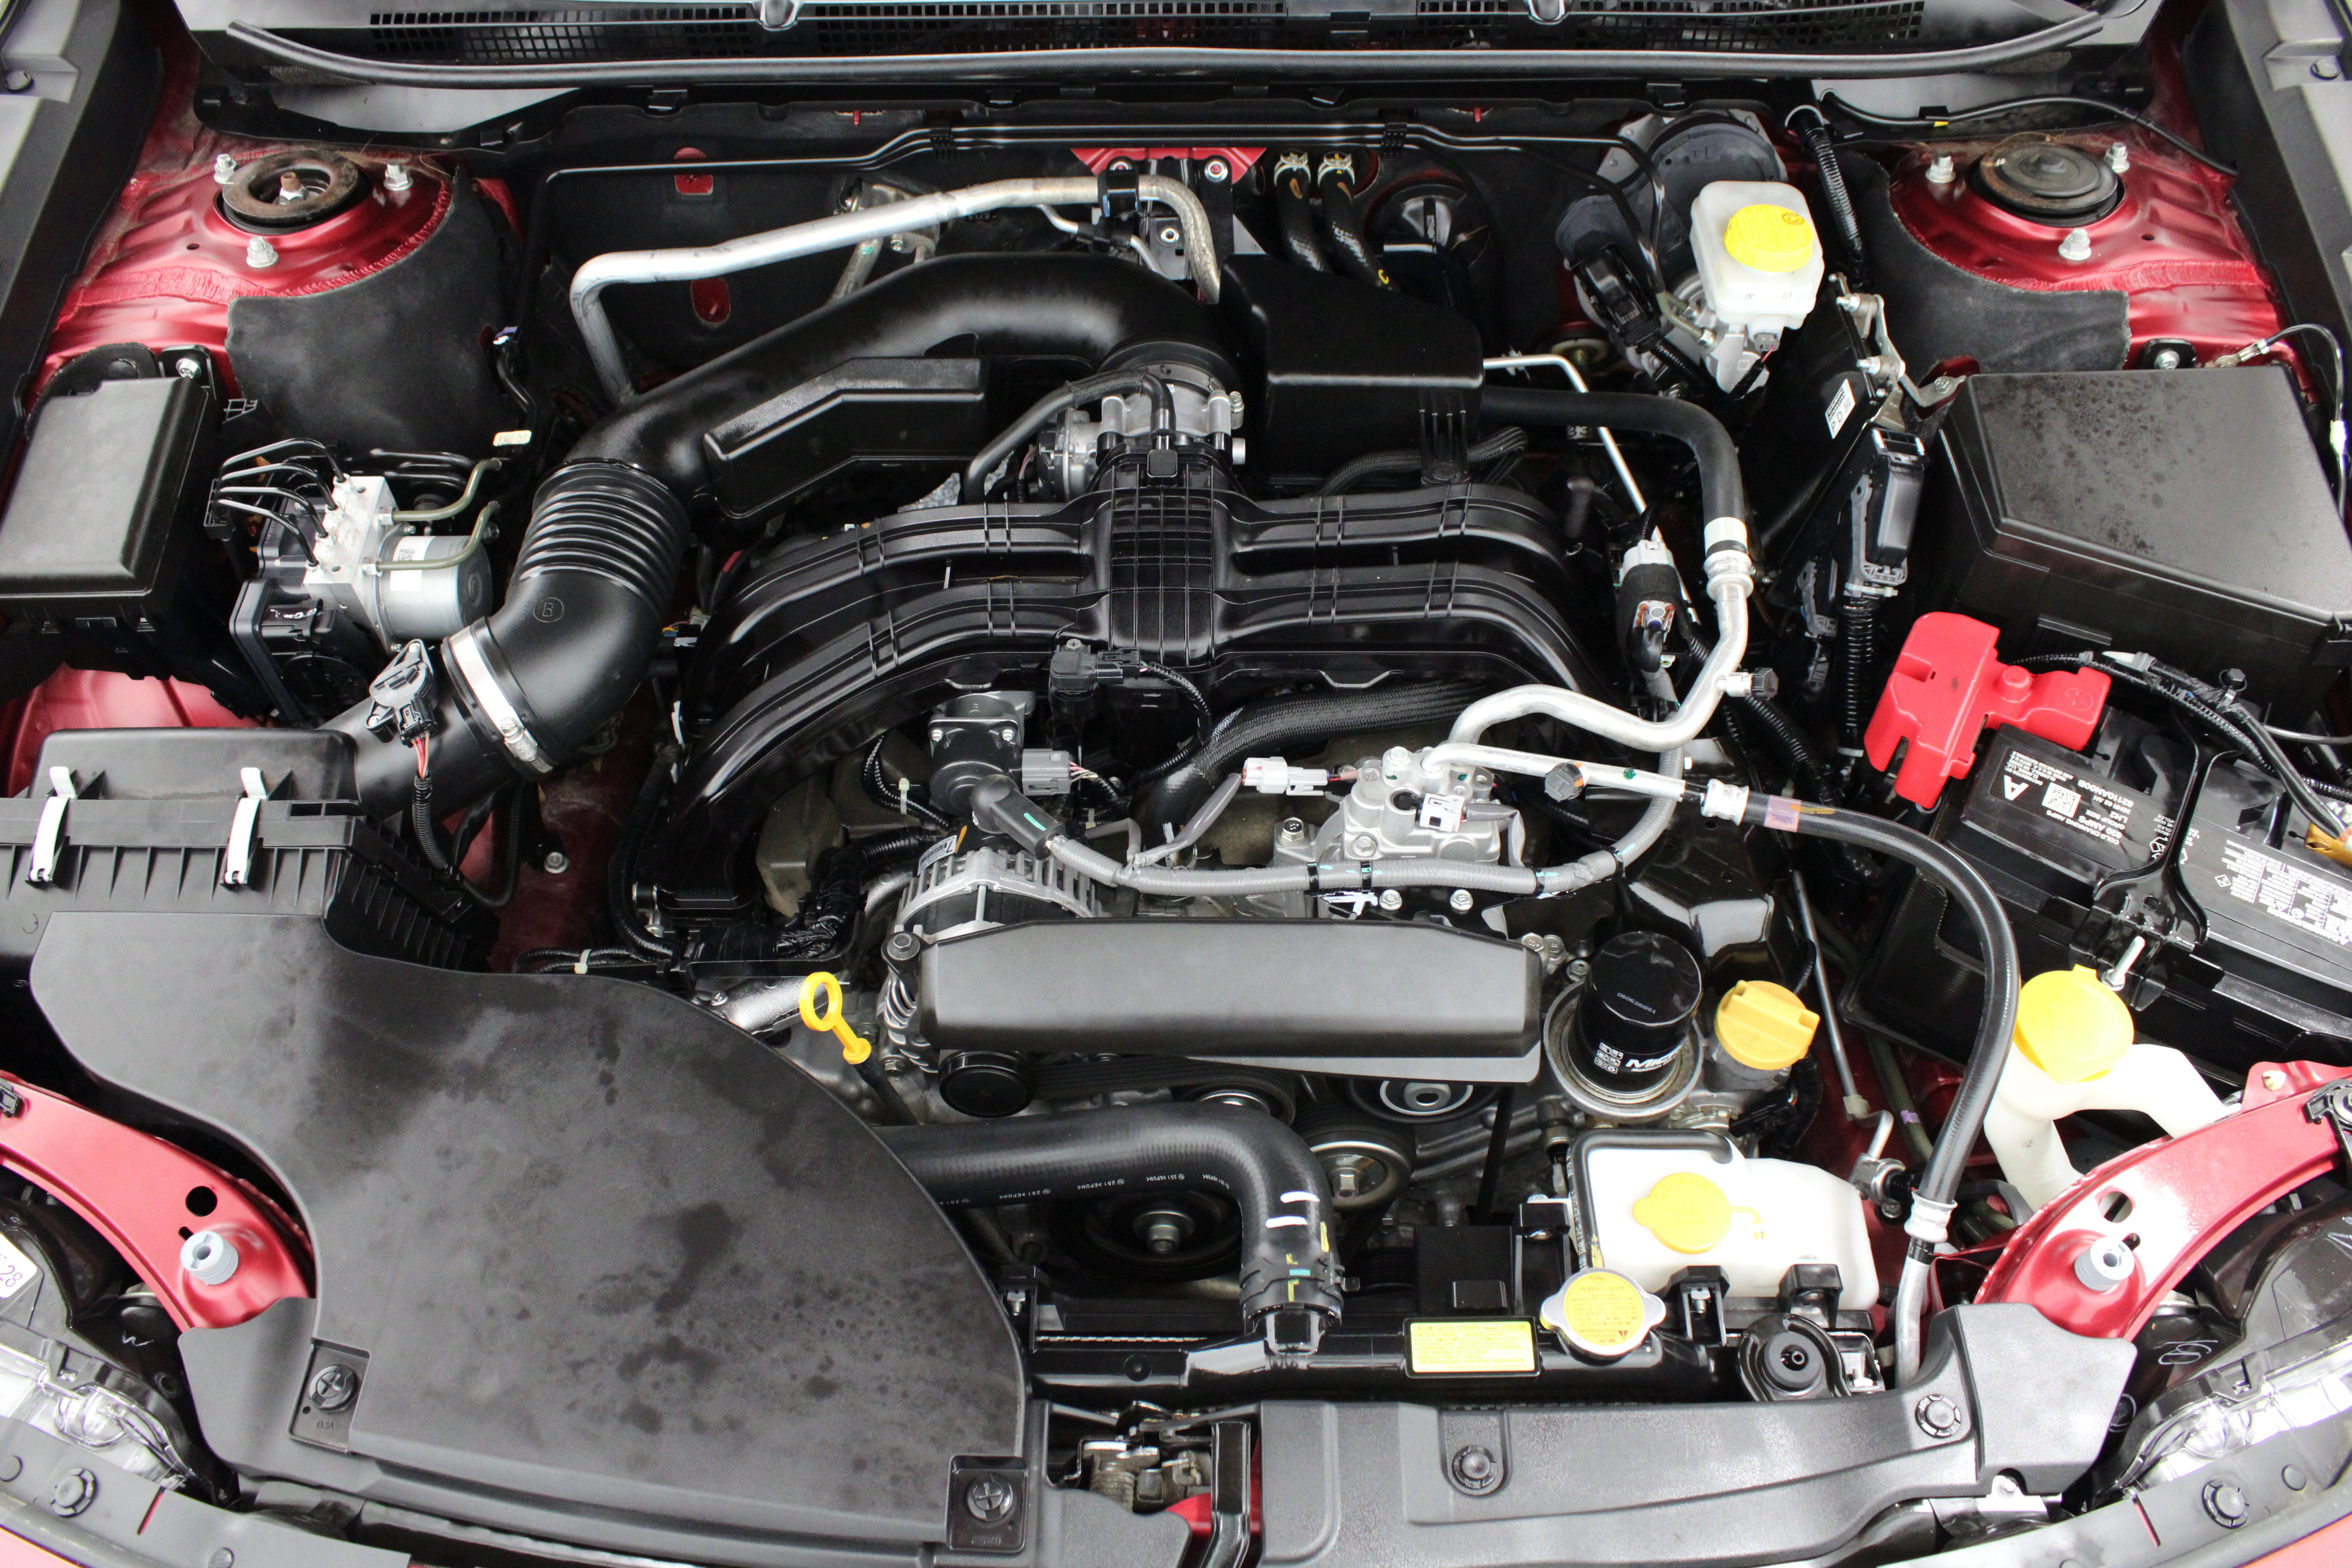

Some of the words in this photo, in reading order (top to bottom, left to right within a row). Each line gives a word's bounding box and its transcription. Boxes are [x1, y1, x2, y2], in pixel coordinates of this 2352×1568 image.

[2011, 750, 2039, 765] MATERIALS
[2038, 761, 2063, 775] IMPORTED
[2012, 768, 2044, 786] DISTRIBUTED
[2052, 772, 2067, 782] MADE
[2062, 772, 2074, 780] AND
[2076, 777, 2134, 809] 82110AN00B
[2092, 794, 2104, 804] AH
[2103, 799, 2114, 807] 62
[2112, 802, 2131, 815] 20HR
[2045, 809, 2066, 822] AMPS
[2085, 808, 2101, 820] SIZE
[2109, 810, 2128, 824] LN2
[2065, 817, 2101, 837] CRANKING
[2077, 814, 2106, 832] AMPS
[2100, 815, 2125, 831] GROUP
[2105, 826, 2123, 839] 620
[2099, 833, 2120, 846] COLD
